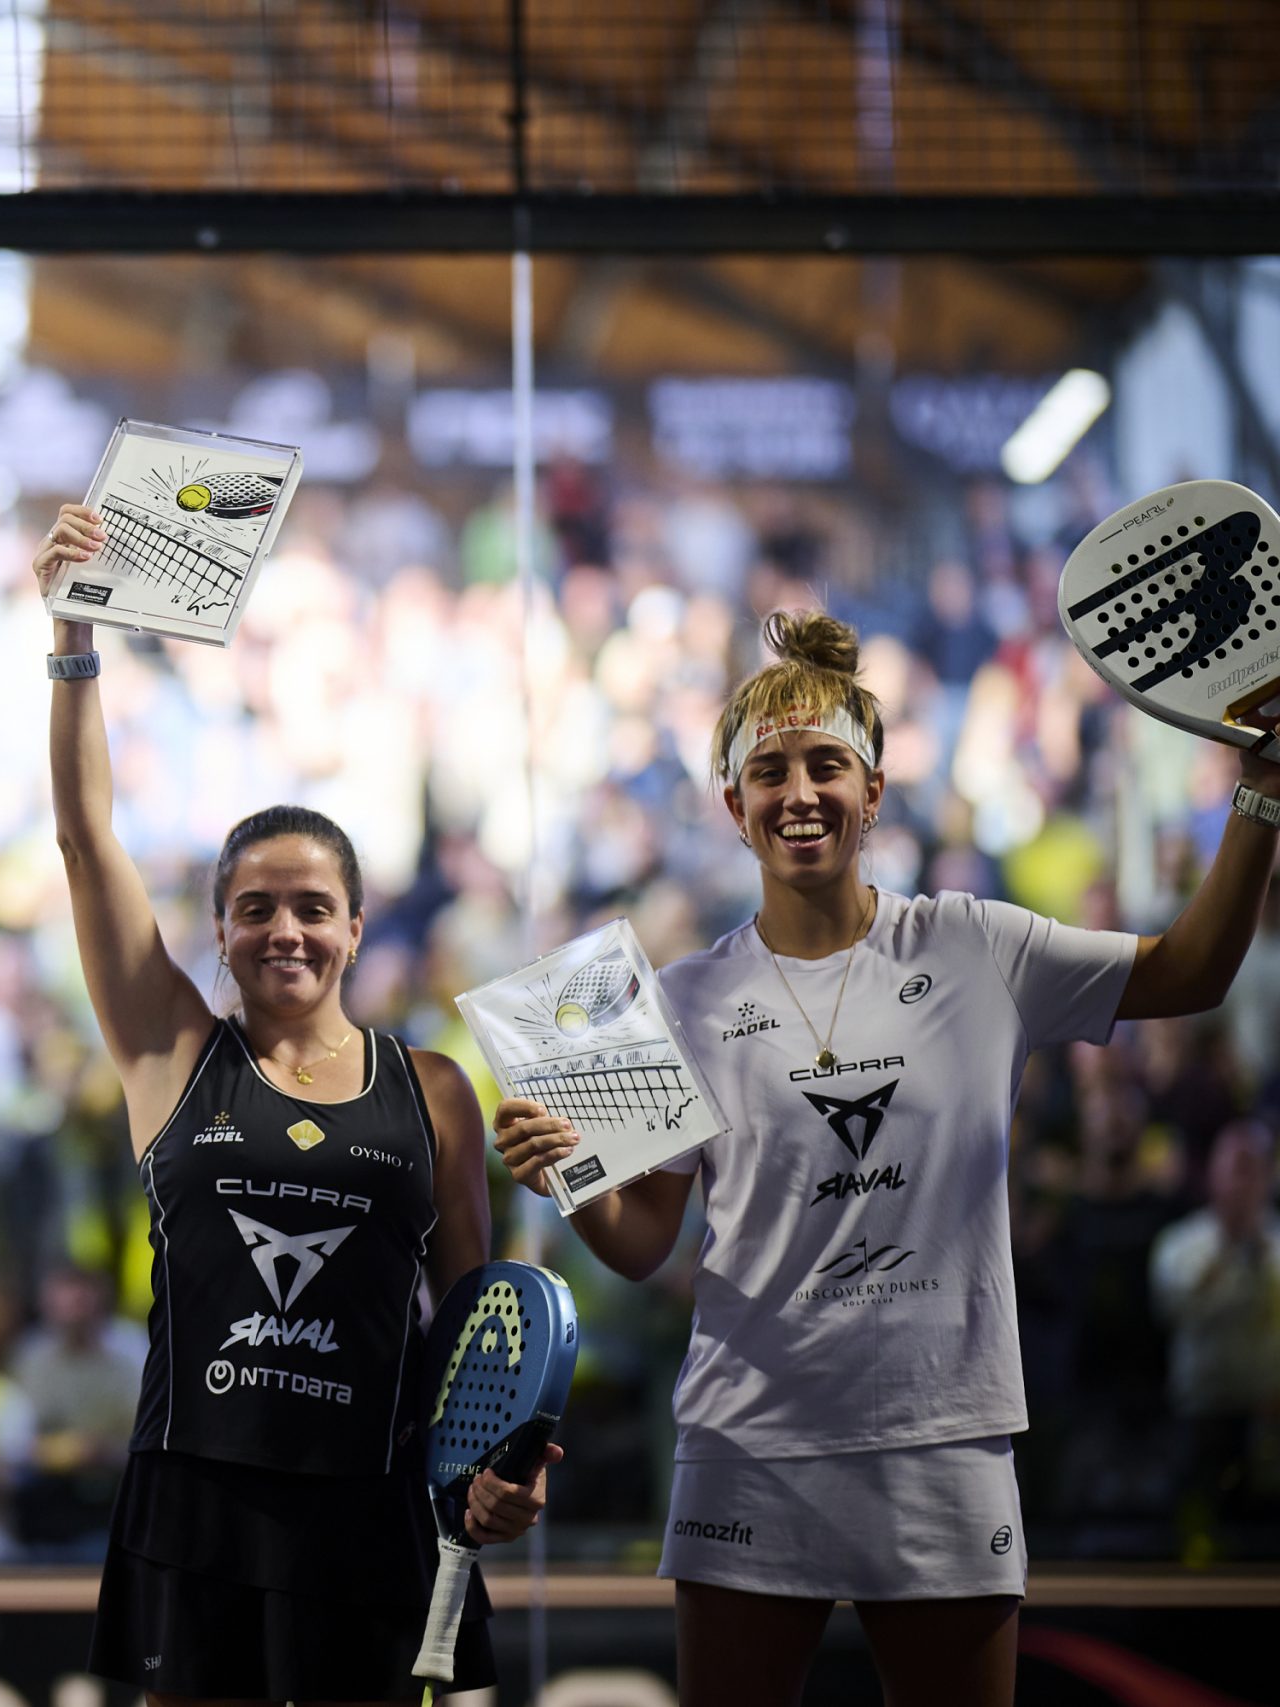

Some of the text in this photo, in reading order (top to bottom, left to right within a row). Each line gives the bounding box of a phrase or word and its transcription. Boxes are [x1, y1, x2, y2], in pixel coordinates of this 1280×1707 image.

[1123, 504, 1166, 531] PEARL
[1208, 645, 1280, 700] Bullpade
[722, 1019, 781, 1042] PADEL
[788, 1055, 906, 1082] CUPRA
[192, 1131, 245, 1146] PADEL
[349, 1145, 402, 1168] OYSHO
[215, 1178, 373, 1214] CUPRA
[795, 1278, 940, 1301] DISCOVERY DUNES
[438, 1462, 481, 1475] EXTREME
[674, 1520, 753, 1546] amazfit
